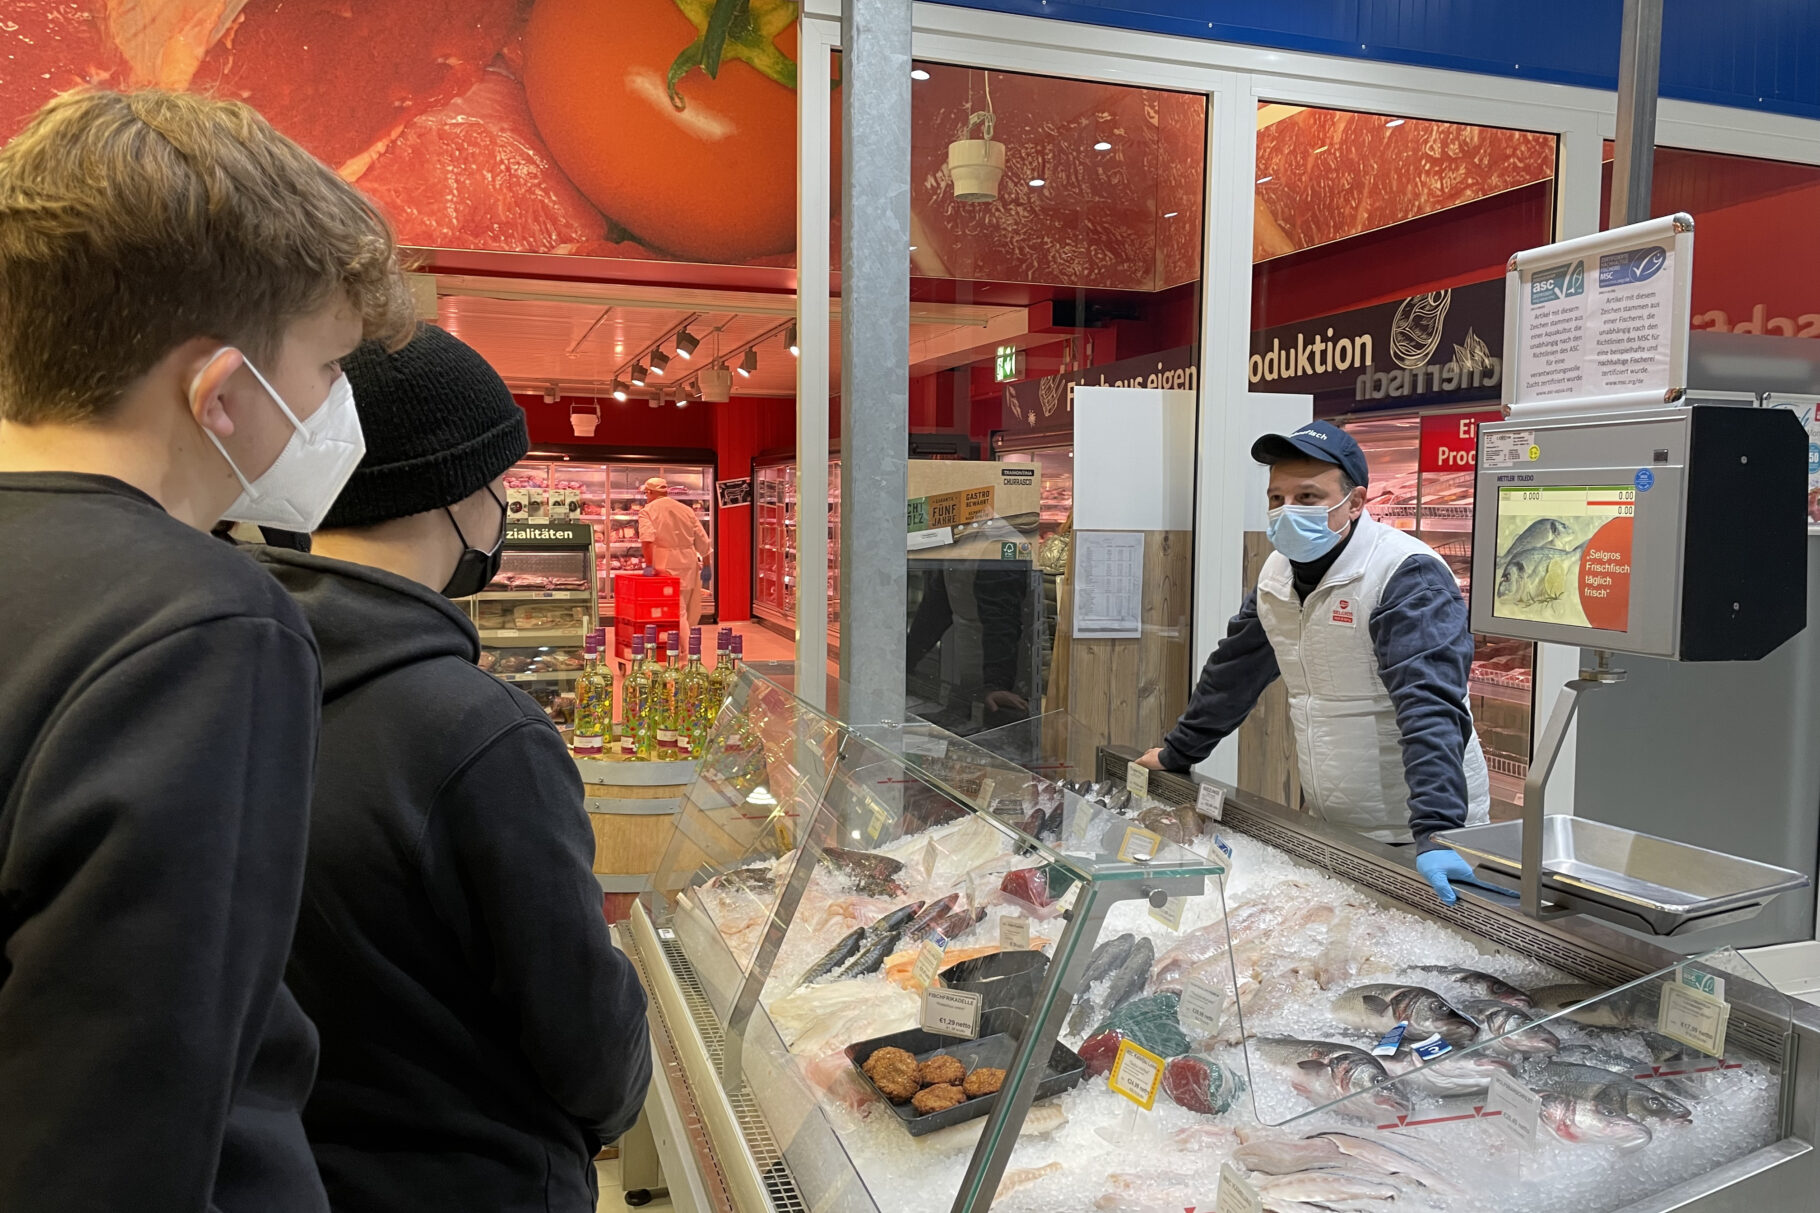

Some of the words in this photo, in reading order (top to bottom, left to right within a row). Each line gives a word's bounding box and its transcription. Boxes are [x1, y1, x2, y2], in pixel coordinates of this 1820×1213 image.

[1533, 280, 1554, 292] asc
[1459, 418, 1475, 438] Ei
[966, 491, 990, 501] GASTRO
[932, 503, 957, 518] FÜNF
[932, 515, 957, 527] JAHRE
[506, 528, 573, 539] zialitäten
[1586, 562, 1630, 573] Frischfisch
[1585, 575, 1612, 587] täglich
[928, 992, 974, 1006] FISCHFRIKADELLE
[956, 1021, 971, 1030] netto
